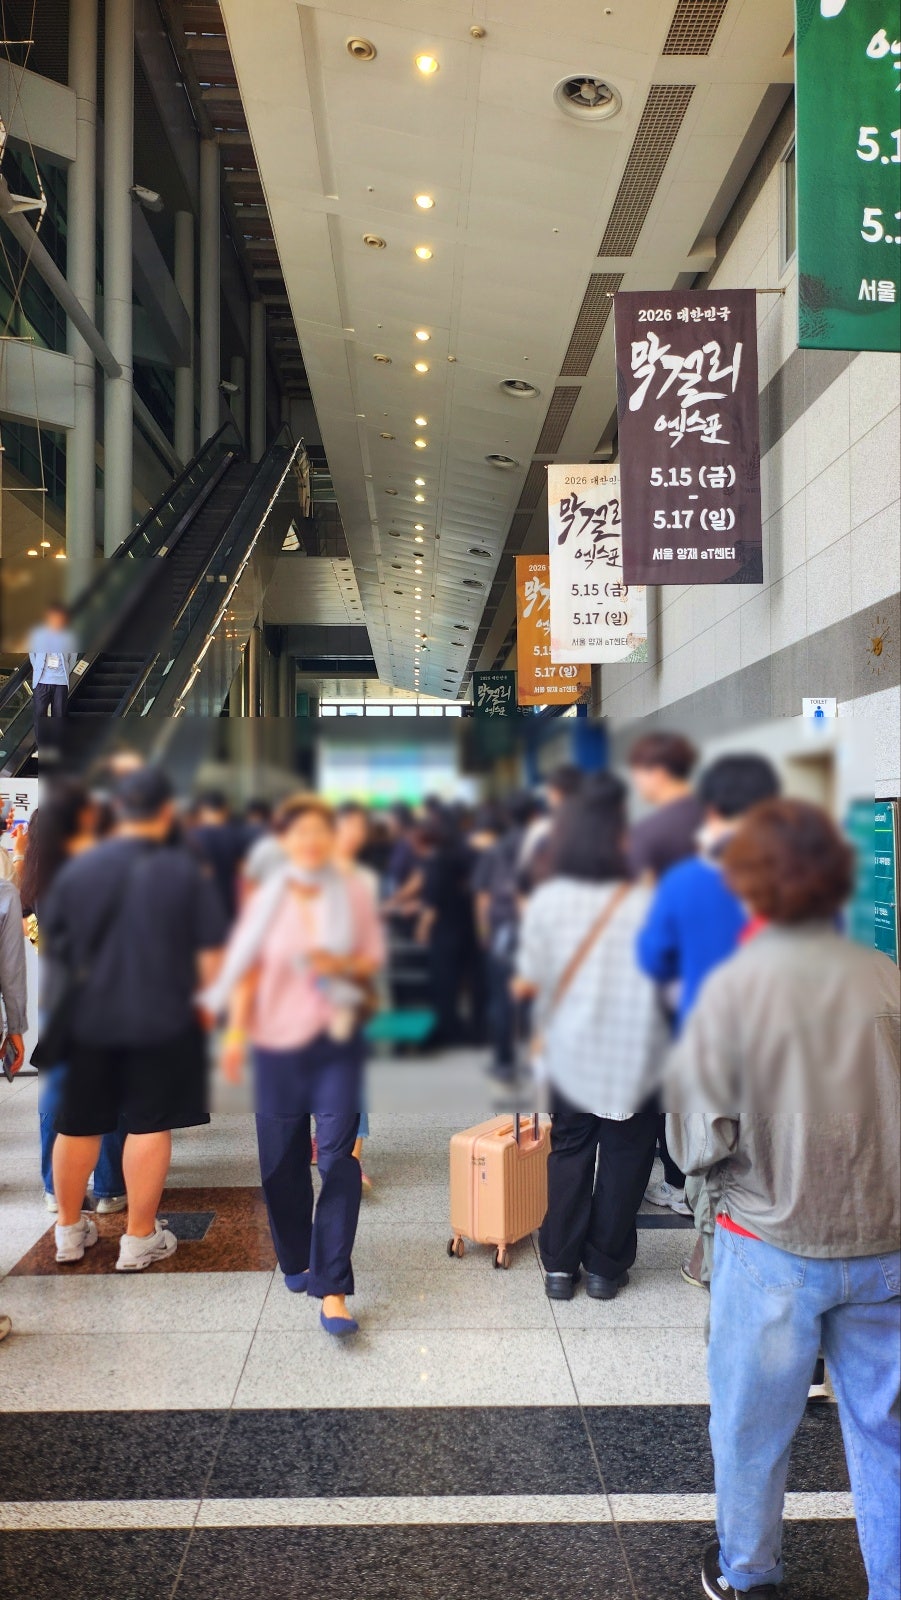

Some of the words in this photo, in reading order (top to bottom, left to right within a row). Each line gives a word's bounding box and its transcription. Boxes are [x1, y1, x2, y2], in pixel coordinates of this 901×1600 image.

[858, 278, 896, 303] 서울
[638, 309, 672, 322] 2026
[677, 307, 731, 323] 대한민국
[629, 331, 743, 412] 막걸리
[654, 408, 730, 448] 엑스포
[565, 476, 587, 485] 2026
[650, 467, 692, 487] 5.15
[698, 465, 736, 488] (금)
[653, 510, 694, 529] 5.17
[700, 508, 736, 531] (일)
[575, 544, 622, 570] 엑스포
[652, 548, 673, 560] 서울
[677, 547, 698, 560] 양재
[701, 547, 736, 560] aT센터
[528, 564, 546, 572] 2026
[571, 583, 599, 597] 5.15
[604, 582, 629, 597] (금)
[572, 612, 600, 625] 5.17
[605, 611, 628, 626] (일)
[572, 637, 585, 646] 서울
[534, 667, 556, 678] 5.17
[559, 665, 577, 678] (일)
[478, 682, 512, 707] 막걸리
